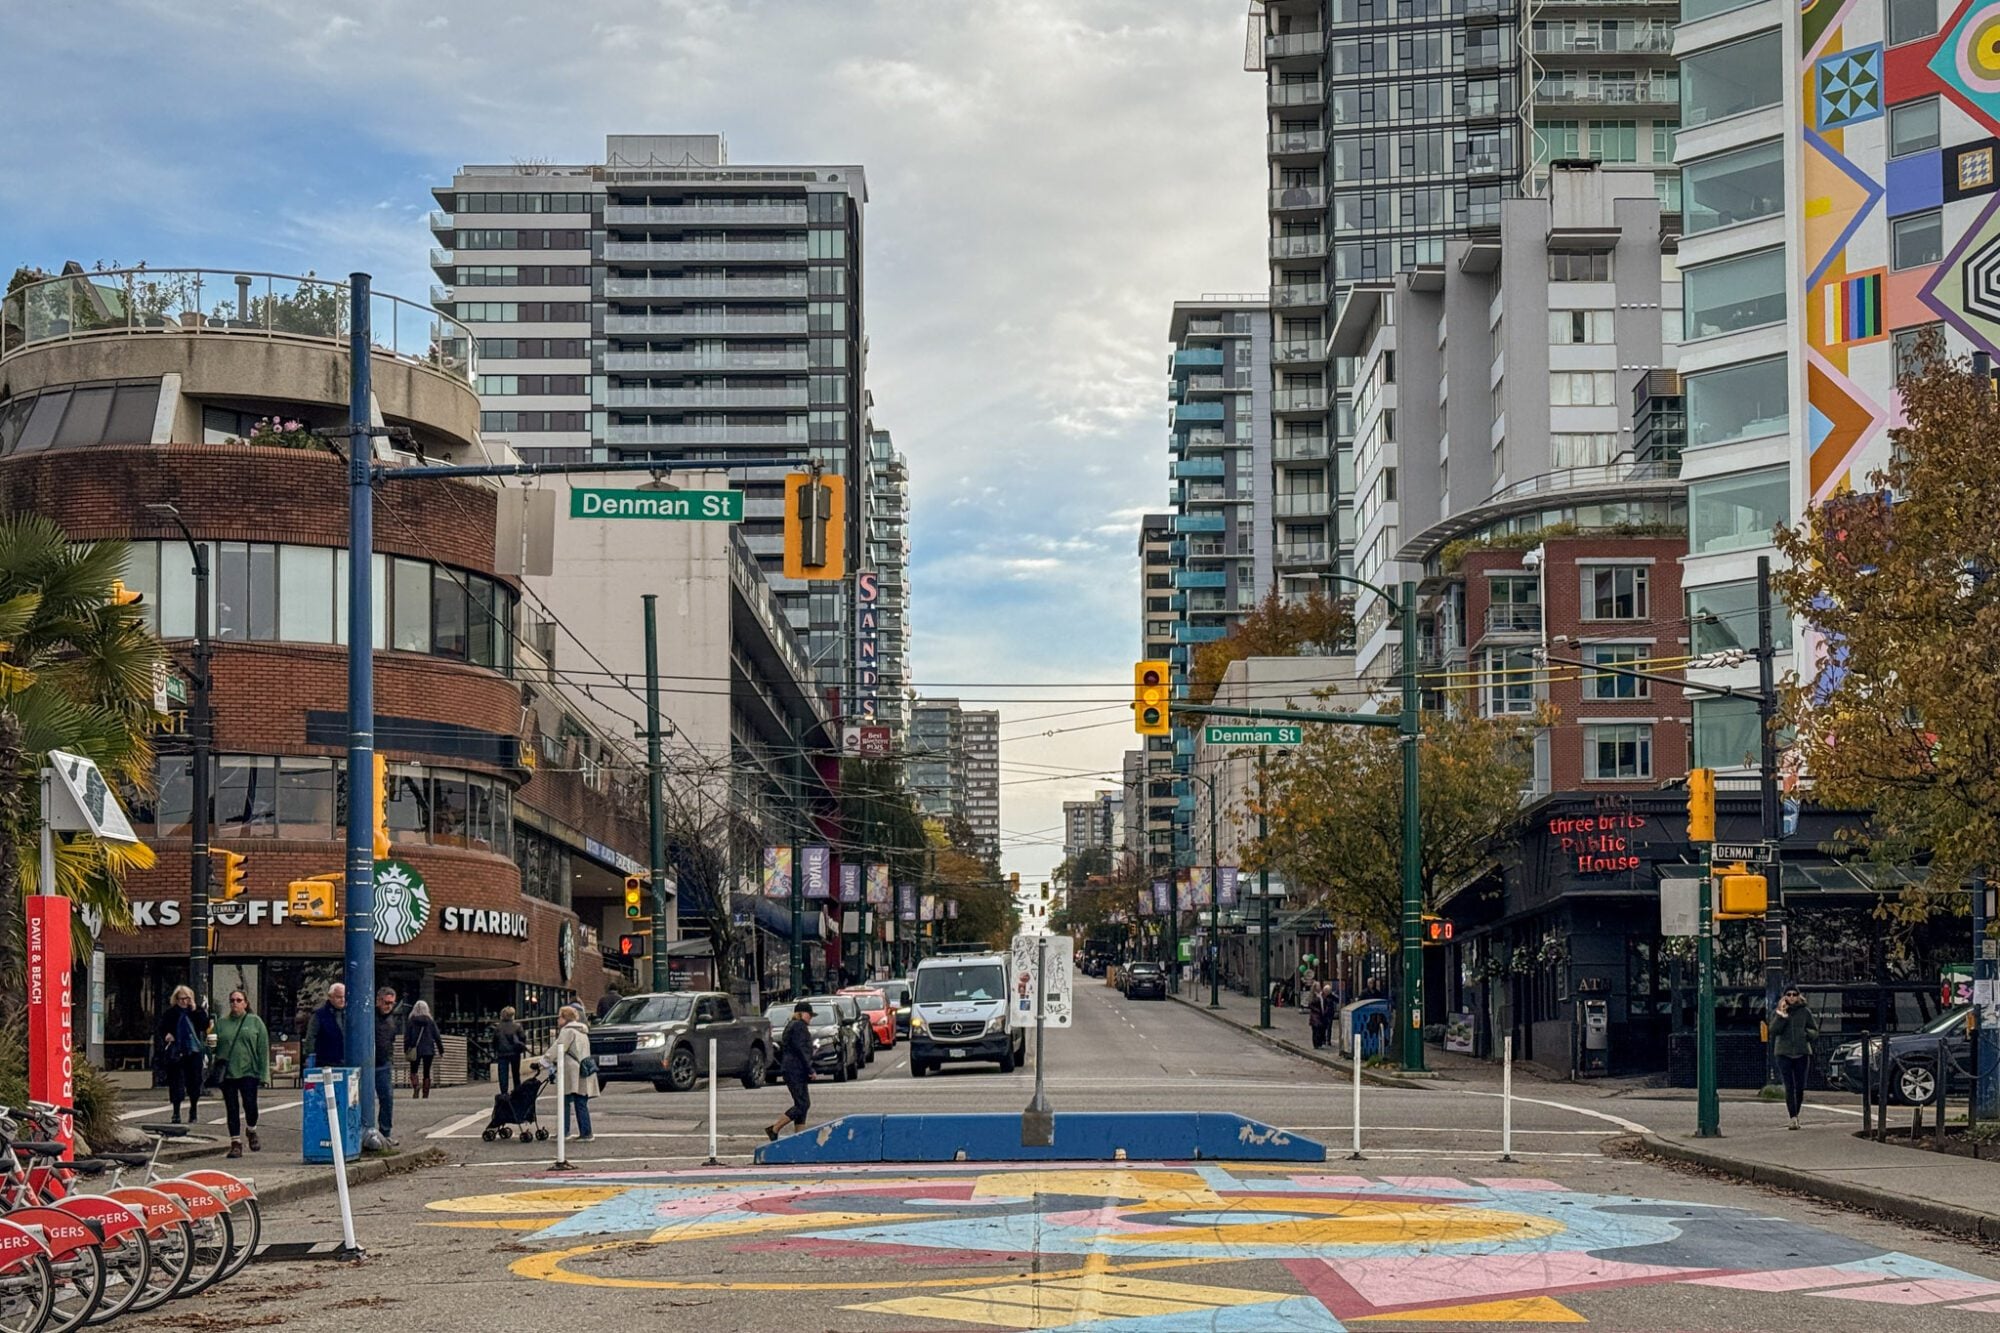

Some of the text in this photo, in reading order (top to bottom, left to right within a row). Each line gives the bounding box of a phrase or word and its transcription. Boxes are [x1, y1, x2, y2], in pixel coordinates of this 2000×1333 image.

[583, 493, 731, 517] Denman St
[860, 574, 878, 720] SANDS
[1212, 728, 1296, 742] Denman St
[1549, 814, 1646, 835] three brits
[1560, 834, 1627, 854] Public
[1718, 845, 1754, 859] DENMAN
[809, 854, 822, 889] DAVIE
[1578, 855, 1640, 873] House
[845, 870, 855, 897] DAVIE
[1222, 866, 1233, 898] DAVIE
[213, 904, 236, 914] DENMAN
[1444, 923, 1453, 939] 0
[31, 917, 42, 1005] DAVIE & BEACH
[61, 970, 73, 1099] ROGERS
[50, 1226, 85, 1239] GERS
